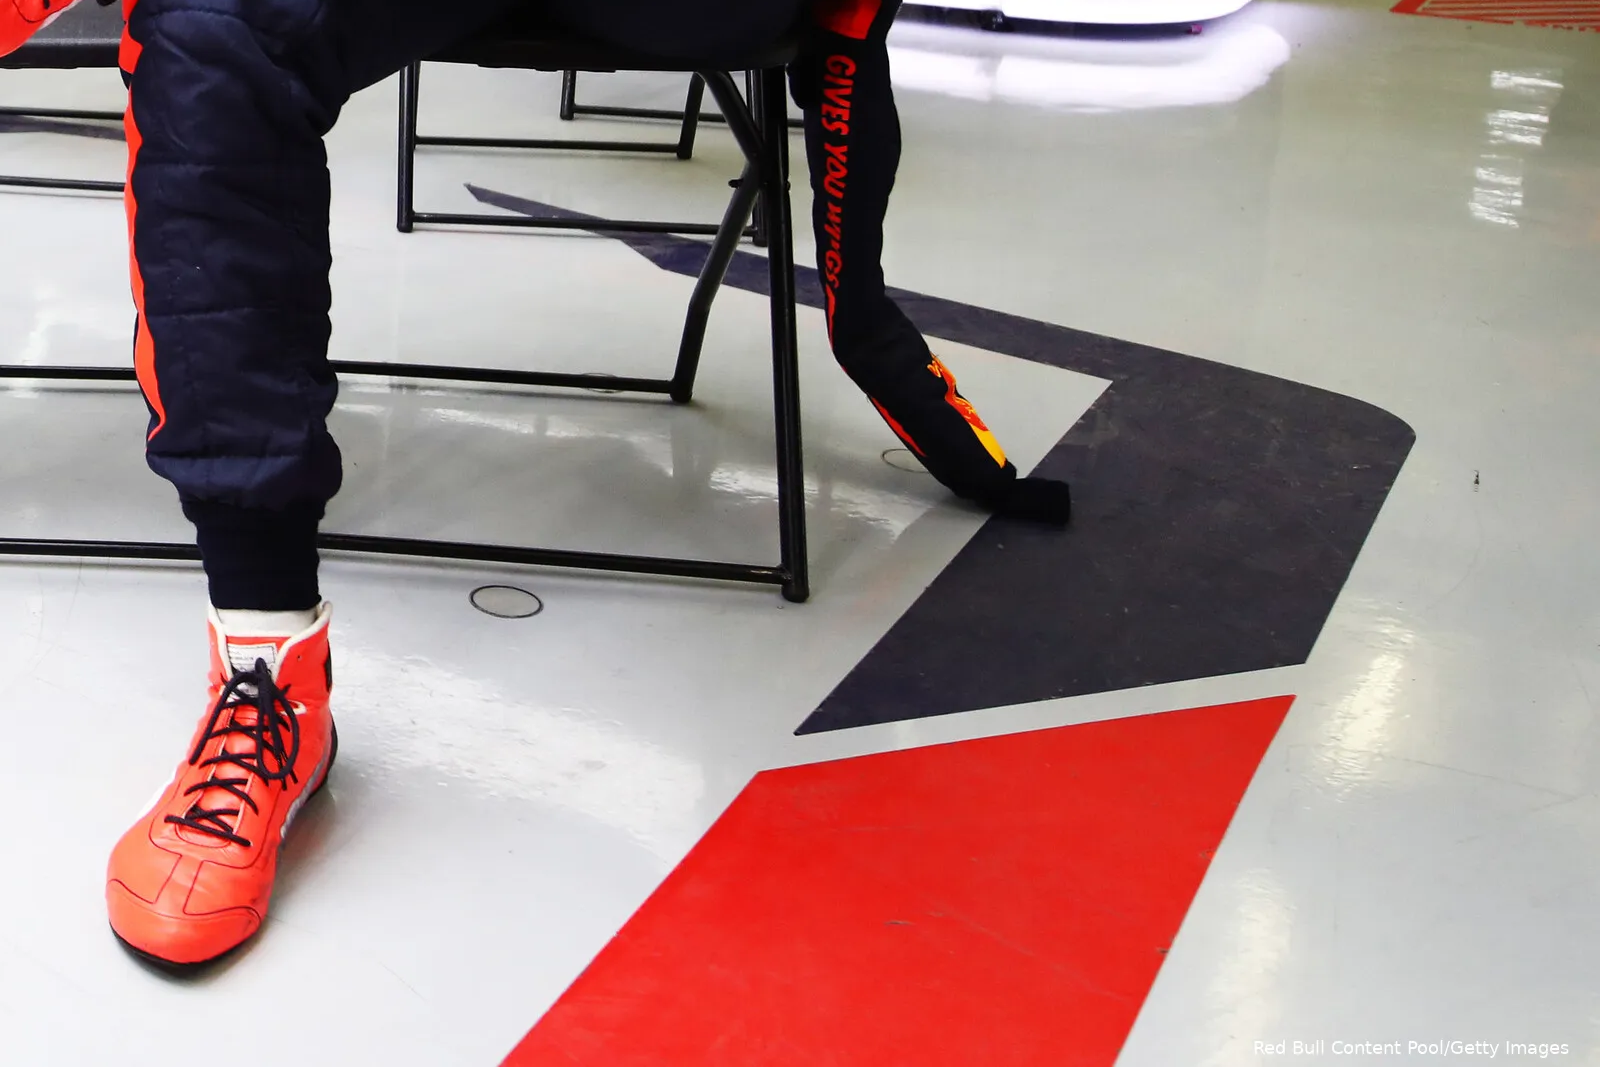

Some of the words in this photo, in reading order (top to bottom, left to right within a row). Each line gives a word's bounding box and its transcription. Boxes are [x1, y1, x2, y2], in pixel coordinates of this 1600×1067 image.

[821, 55, 858, 137] GIVES
[824, 142, 849, 200] YOU
[824, 202, 843, 289] WIGS
